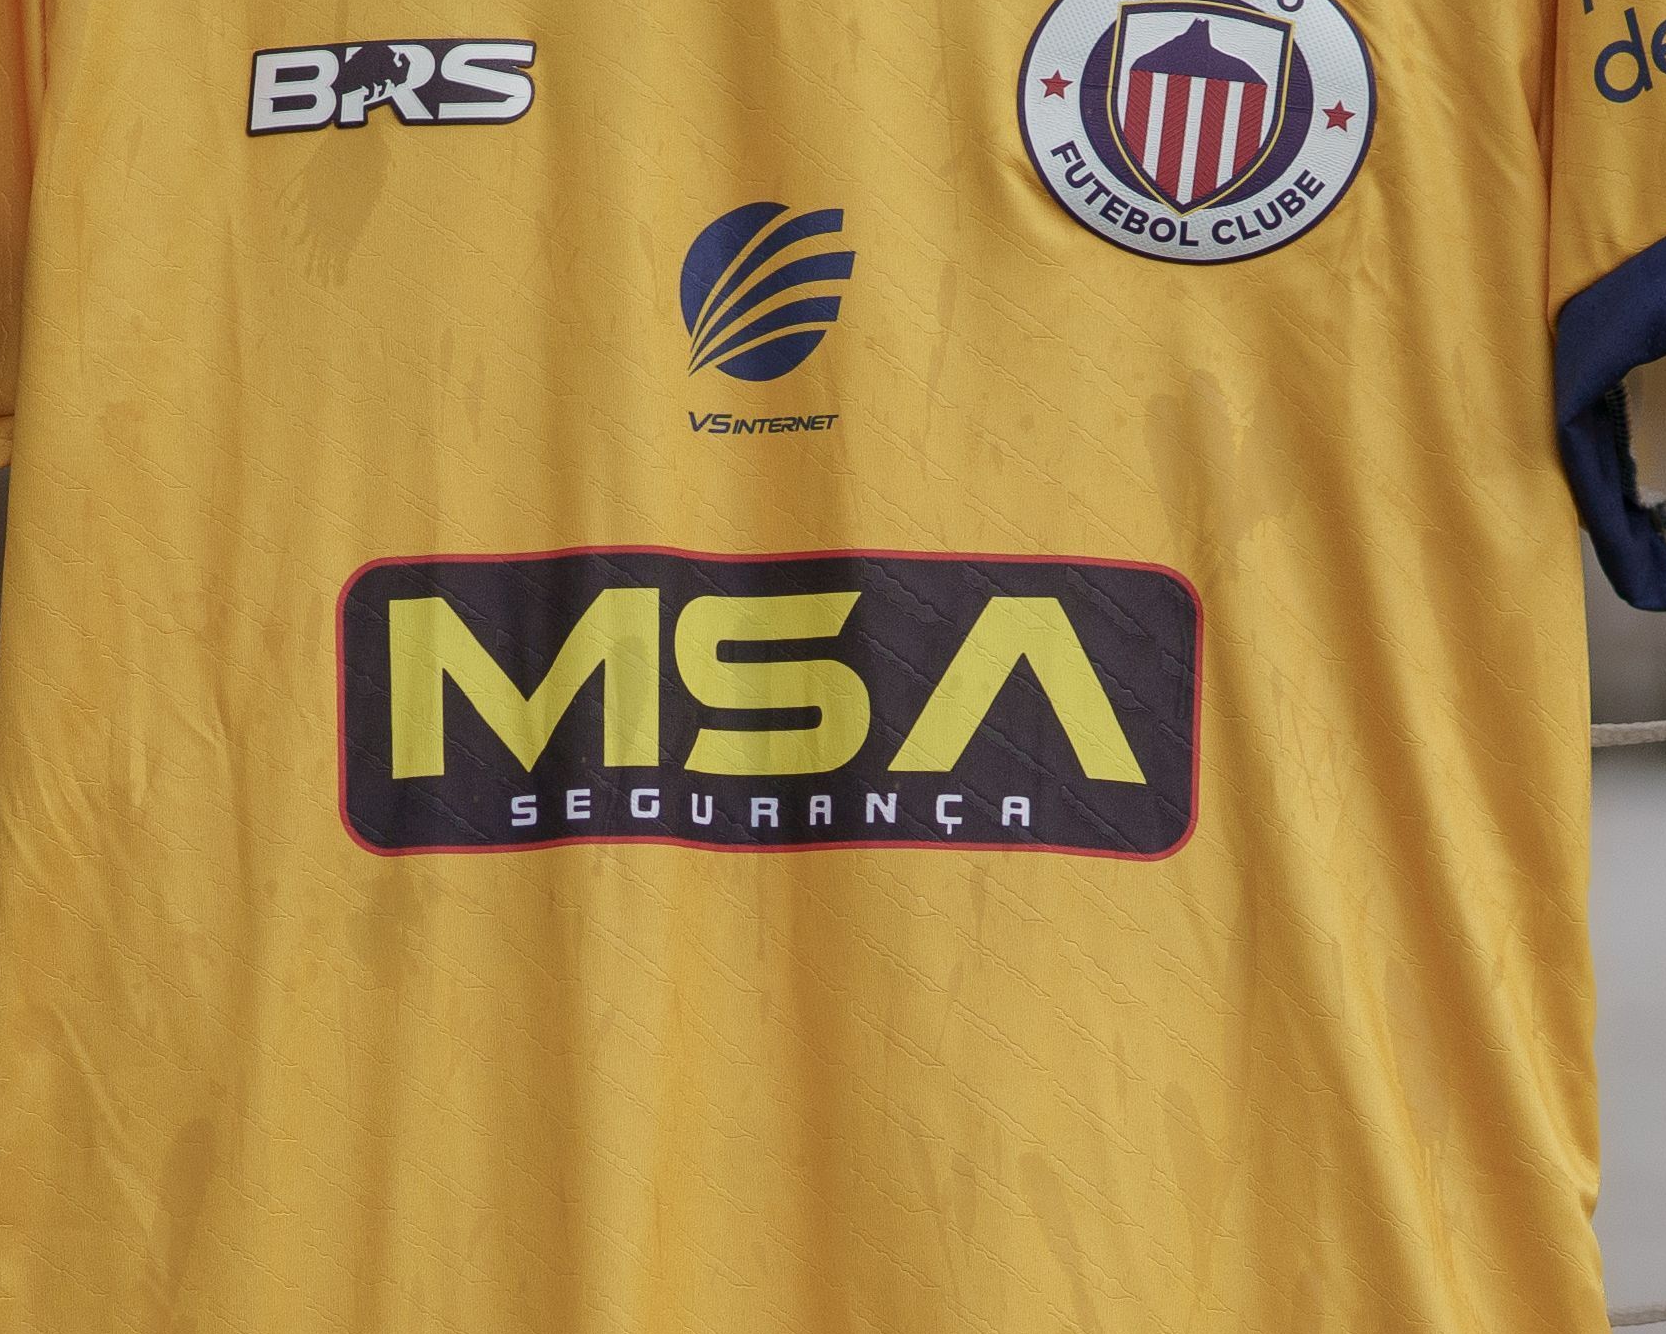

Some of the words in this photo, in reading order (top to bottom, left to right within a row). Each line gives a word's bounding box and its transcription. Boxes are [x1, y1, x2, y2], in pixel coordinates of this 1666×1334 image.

[249, 41, 536, 134] BRS
[1050, 140, 1200, 247] FUTEBOL
[1211, 169, 1326, 245] CLUBE
[388, 586, 1148, 786] MSA
[510, 787, 1032, 835] SEGURANÇA
